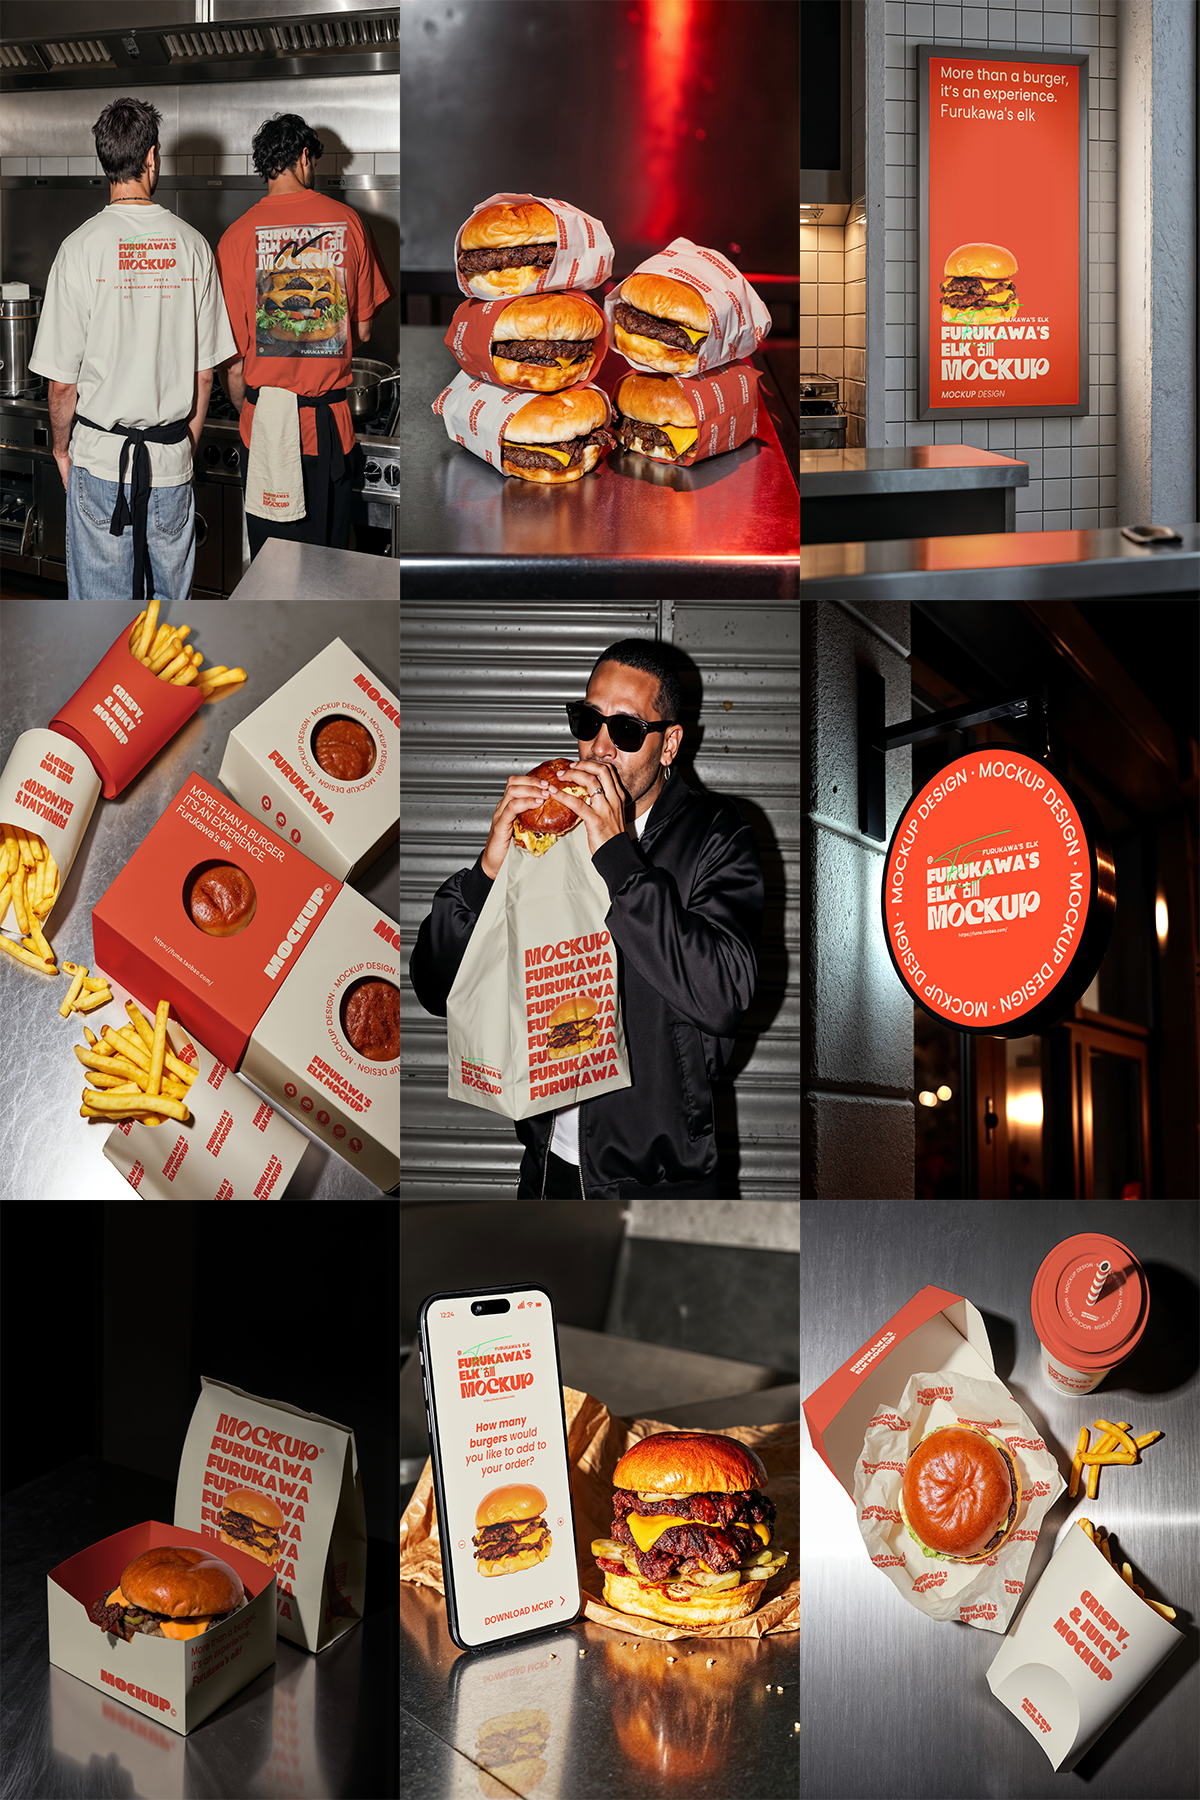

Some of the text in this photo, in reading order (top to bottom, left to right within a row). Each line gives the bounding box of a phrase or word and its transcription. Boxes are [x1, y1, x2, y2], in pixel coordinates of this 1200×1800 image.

[940, 66, 1069, 88] More than a burger,
[940, 84, 1058, 103] it's an experience.
[940, 104, 1036, 122] Furukawa's elk
[119, 242, 176, 250] FURUKAWA'S
[258, 251, 344, 270] MOCKUP
[119, 258, 176, 270] MOCKUP
[941, 326, 1050, 340] FURUKAWA'S
[941, 343, 971, 357] ELK
[941, 358, 1050, 380] MOCKUP
[941, 390, 976, 398] MOCKUP
[104, 695, 136, 732] & JUICY
[112, 684, 144, 724] CRISPY,
[311, 702, 367, 718] MOCKUP DESIGN
[92, 703, 129, 744] MOCKUP
[45, 751, 75, 775] READY?
[297, 717, 316, 778] MOCKUP DESIGN
[369, 717, 387, 777] MOCKUP DESIGN
[40, 759, 73, 785] ARE YOU
[268, 749, 335, 825] FURUKAWA
[318, 778, 376, 794] MOCKUP DESIGN
[14, 790, 69, 830] FURUKAWA'S
[24, 778, 74, 816] ELK MOCKUP
[197, 807, 213, 821] AN
[978, 761, 1081, 858] MOCKUP DESIGN
[176, 804, 233, 853] Furukawa's elk
[190, 785, 286, 863] MORE THAN A BURGER,
[891, 768, 968, 904] MOCKUP DESIGN
[982, 840, 1039, 856] FURUKAWA'S ELK
[926, 851, 1040, 885] FURUKAWA'S
[927, 884, 957, 904] ELK
[927, 890, 1041, 931] MOCKUP
[263, 887, 325, 980] MOCKUP
[525, 930, 611, 968] MOCKUP
[999, 871, 1083, 1014] MOCKUP DESIGN
[334, 962, 396, 989] MOCKUP DESIGN
[525, 951, 613, 985] FURUKAWA
[525, 967, 614, 1001] FURUKAWA
[893, 920, 988, 1018] MOCKUP DESIGN
[326, 993, 354, 1065] MOCKUP DESIGN
[312, 1054, 372, 1108] FURUKAWA'S
[357, 1063, 387, 1077] DESIGN
[529, 1047, 618, 1084] FURUKAWA
[530, 1063, 619, 1101] FURUKAWA
[306, 1063, 363, 1113] ELK MOCKUP
[462, 1074, 502, 1095] MOCKUP
[206, 1109, 230, 1152] FURUKAWA'S
[211, 1117, 233, 1158] ELK MOCKUP
[162, 1134, 185, 1177] FURUKAWA'S
[167, 1142, 189, 1183] ELK MOCKUP
[253, 1154, 278, 1199] FURUKAWA'S
[265, 1162, 283, 1193] MOCKUP
[440, 1311, 454, 1319] 12:24
[458, 1349, 532, 1369] FURUKAWA'S
[867, 1335, 896, 1363] MOCKUP
[459, 1368, 481, 1381] ELK
[460, 1372, 534, 1399] MOCKUP
[215, 1412, 319, 1462] MOCKUP
[470, 1427, 538, 1448] burgers would
[476, 1416, 527, 1433] How many
[210, 1435, 313, 1485] FURUKAWA
[465, 1441, 547, 1467] you like to add to
[481, 1456, 535, 1479] your order?
[206, 1452, 309, 1504] FURUKAWA
[484, 1599, 554, 1626] DOWNLOAD MCKP
[1080, 1589, 1130, 1650] CRISPY,
[191, 1611, 257, 1657] More than a burger,
[1053, 1616, 1113, 1682] MOCKUP
[1069, 1606, 1121, 1662] & JUICY
[191, 1659, 202, 1672] it's
[203, 1654, 213, 1666] an
[101, 1668, 171, 1713] MOCKUP
[1022, 1697, 1052, 1732] ARE YOU
